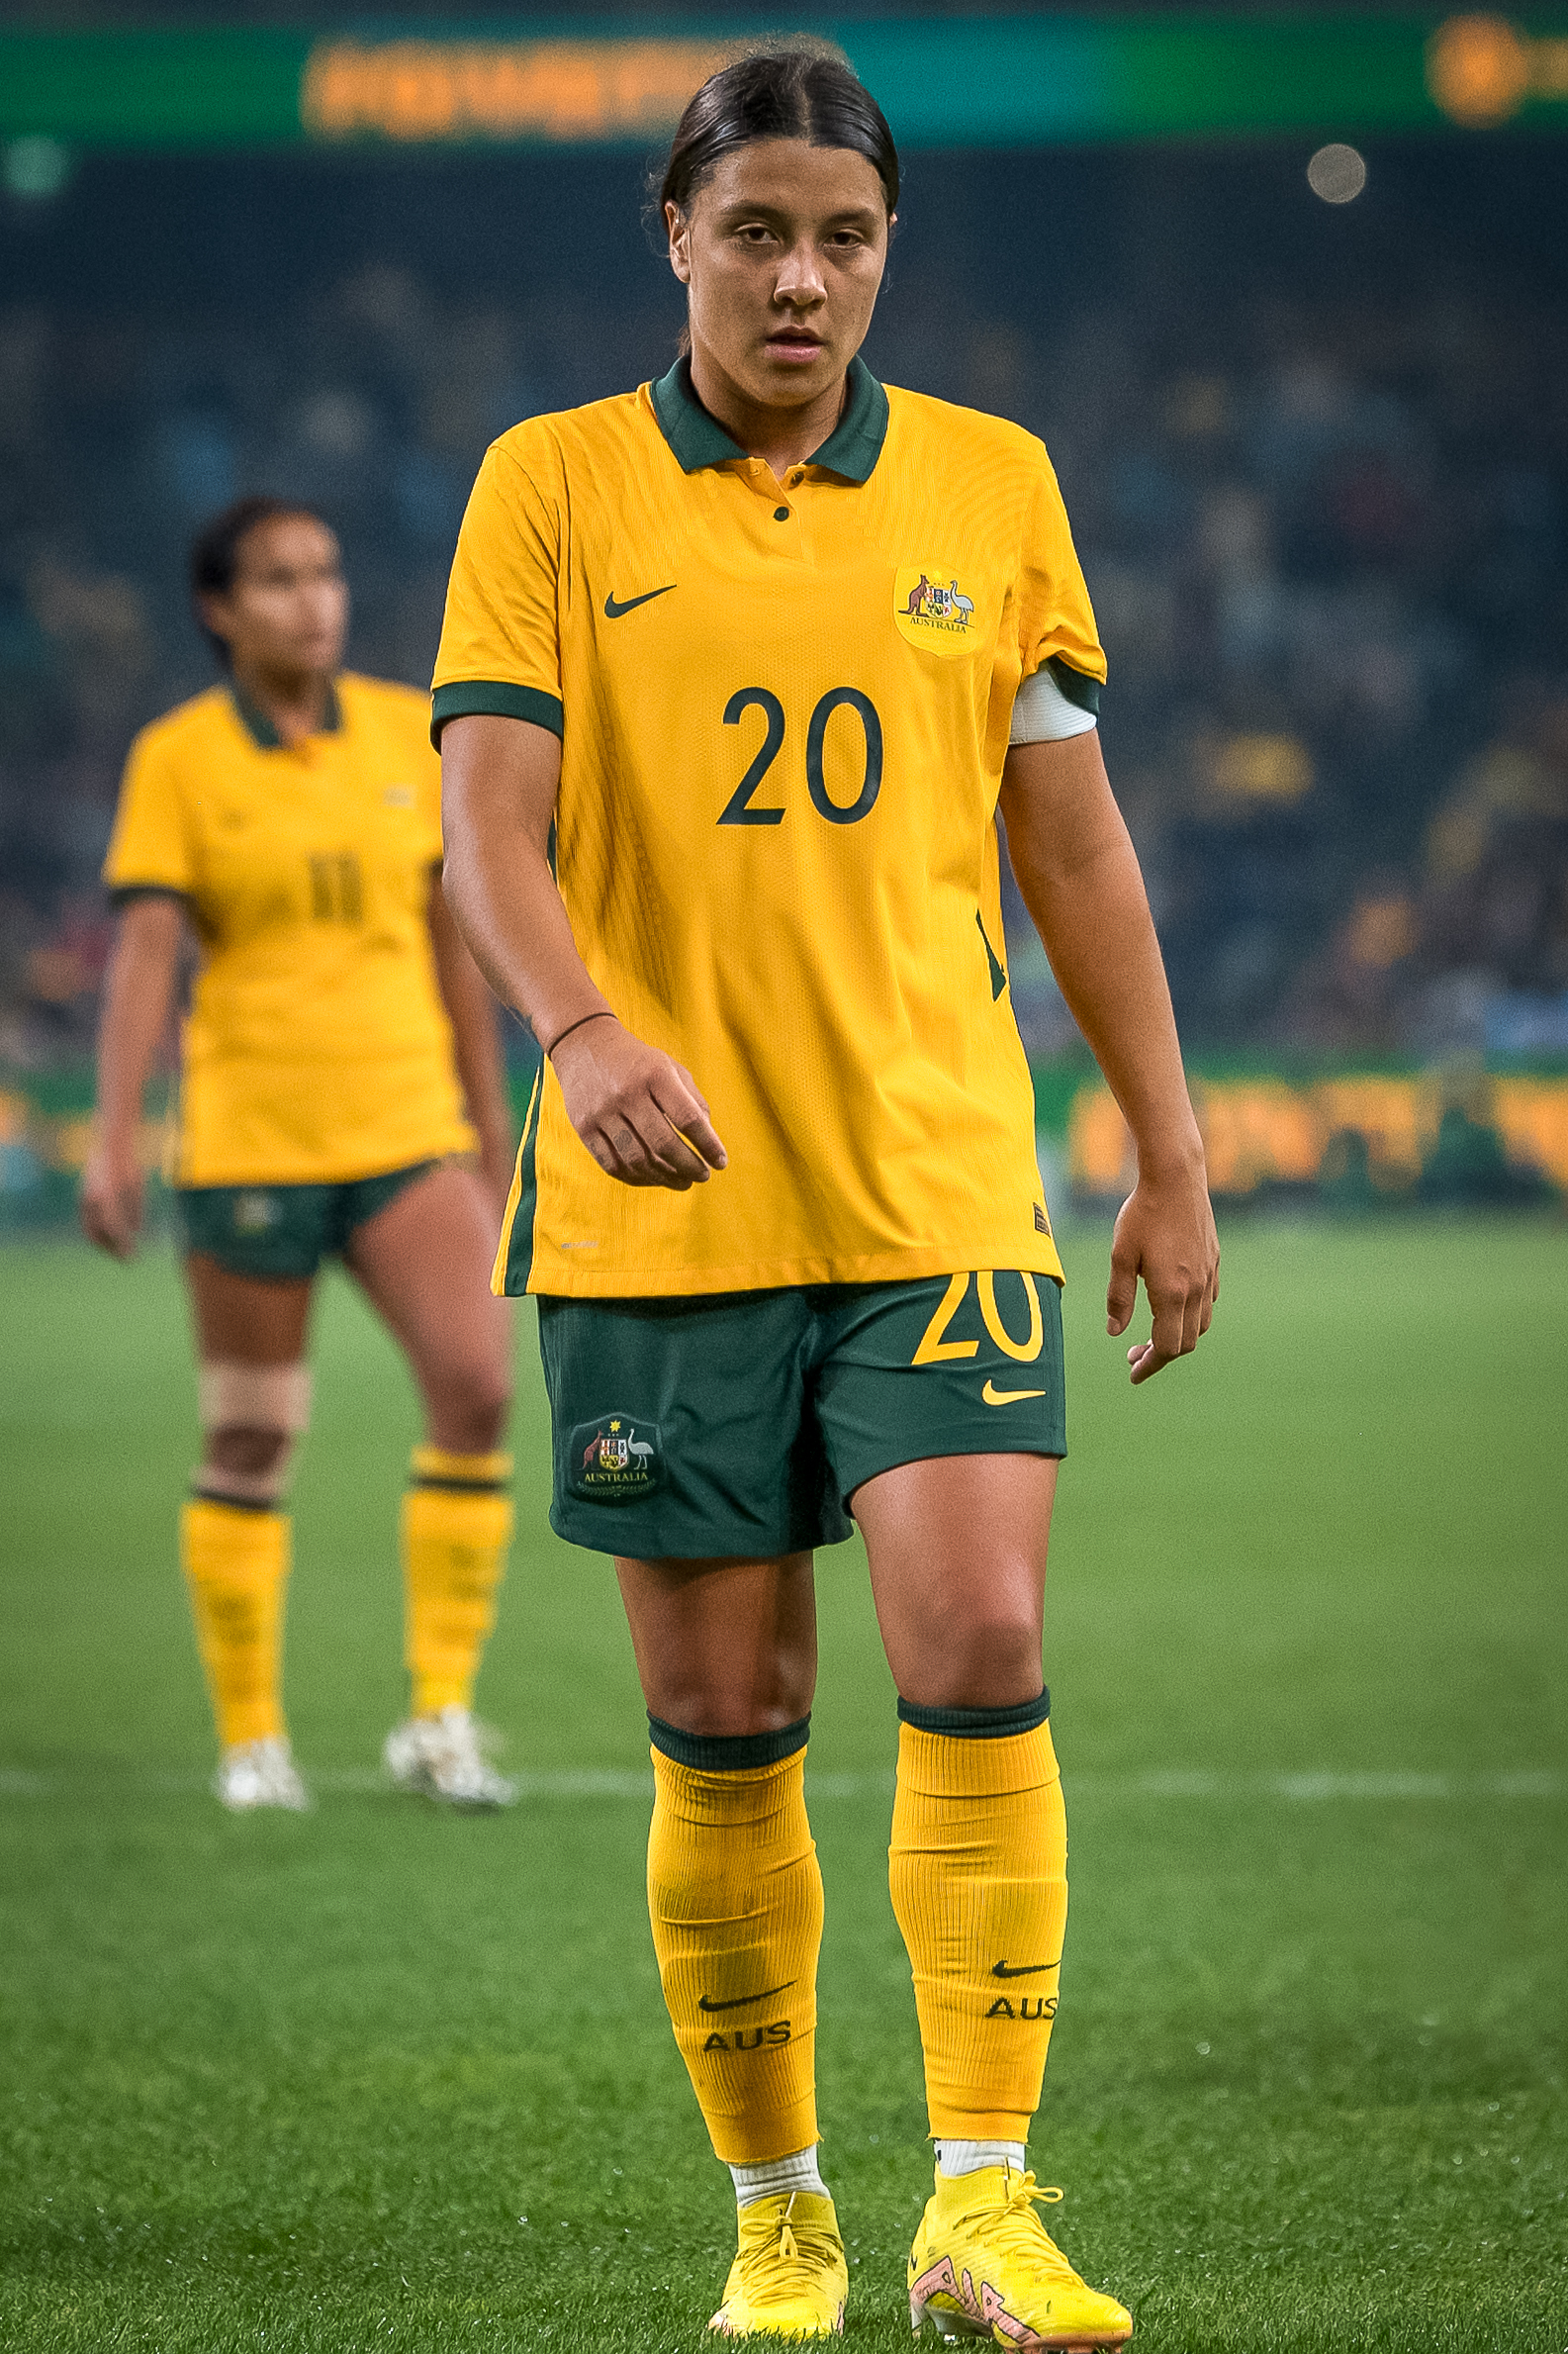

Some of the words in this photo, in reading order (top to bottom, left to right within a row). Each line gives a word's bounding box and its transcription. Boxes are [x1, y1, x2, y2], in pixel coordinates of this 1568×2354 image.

[910, 616, 967, 634] AUSTRALIA
[716, 687, 882, 824] 20
[911, 1271, 1044, 1365] 20
[585, 1472, 648, 1482] AUSTRALIA
[984, 1997, 1058, 2021] AUS
[703, 2020, 791, 2052] AUS
